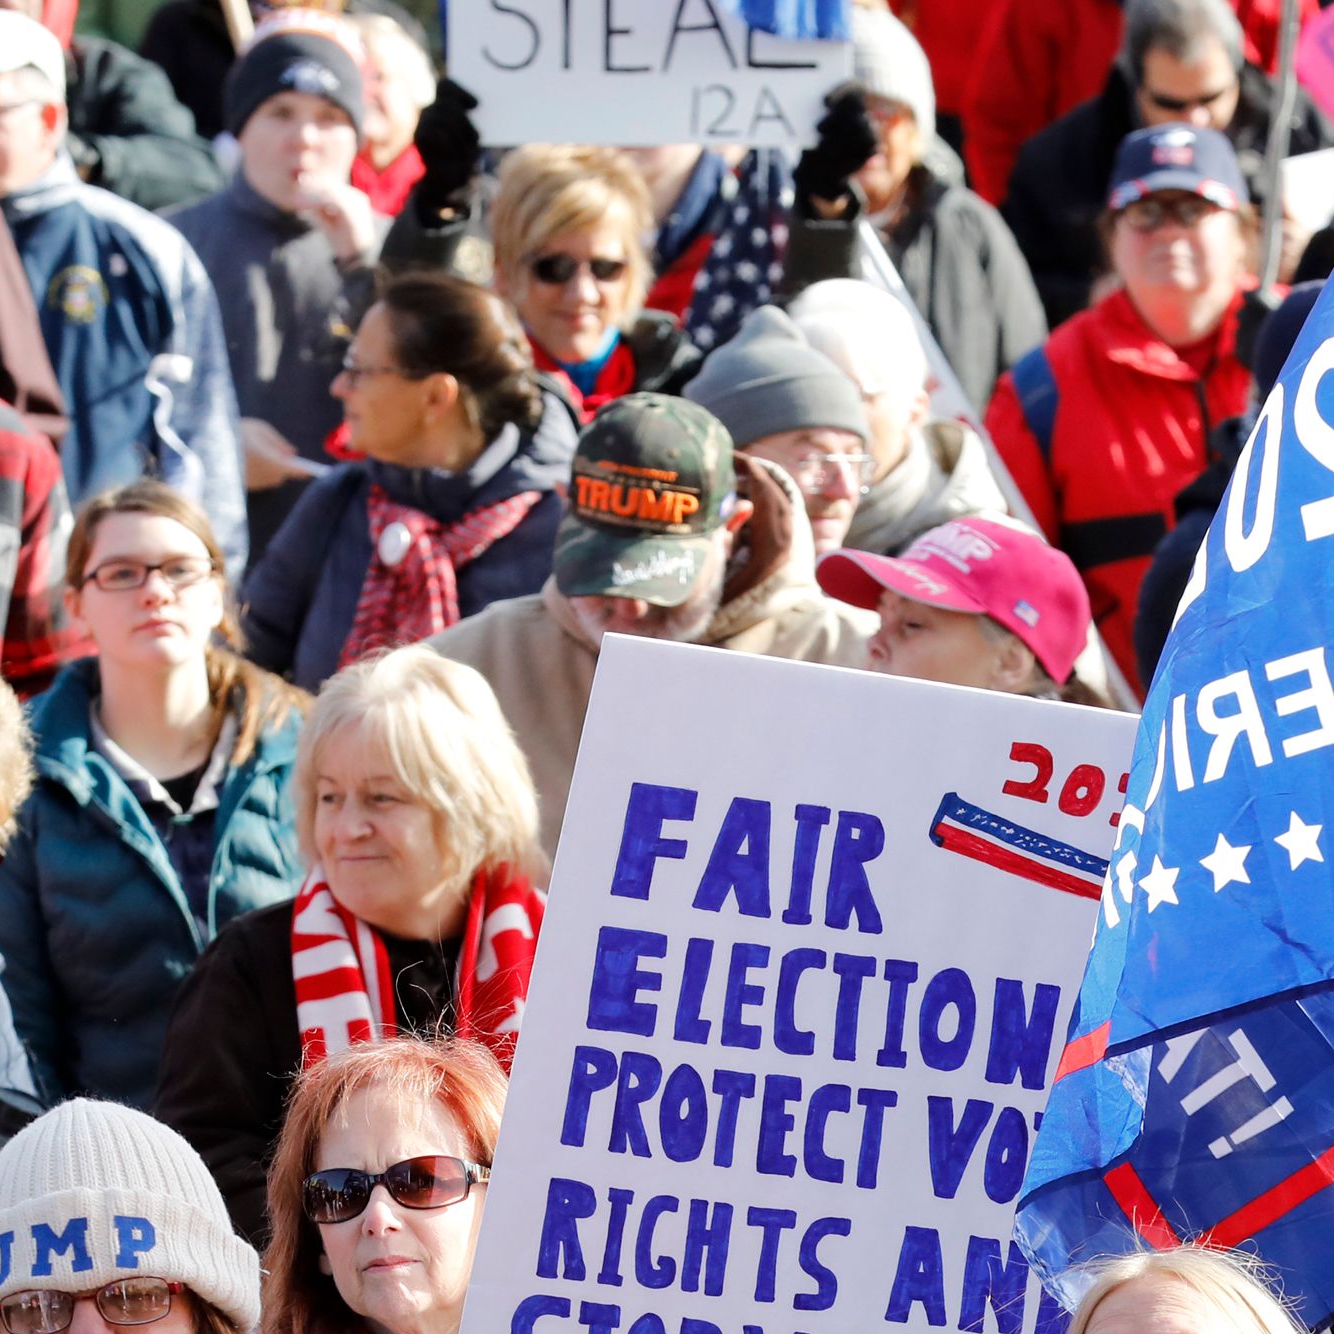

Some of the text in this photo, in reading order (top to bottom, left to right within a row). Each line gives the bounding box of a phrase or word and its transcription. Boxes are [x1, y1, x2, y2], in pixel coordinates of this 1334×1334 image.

[691, 83, 796, 138] 12A
[575, 475, 680, 525] TRUMP
[1002, 741, 1130, 829] 20
[611, 782, 885, 934] FAIR
[586, 926, 1061, 1091] ELECTION
[560, 1046, 1044, 1204] PROTECT VO
[536, 1178, 851, 1311] RIGHTS
